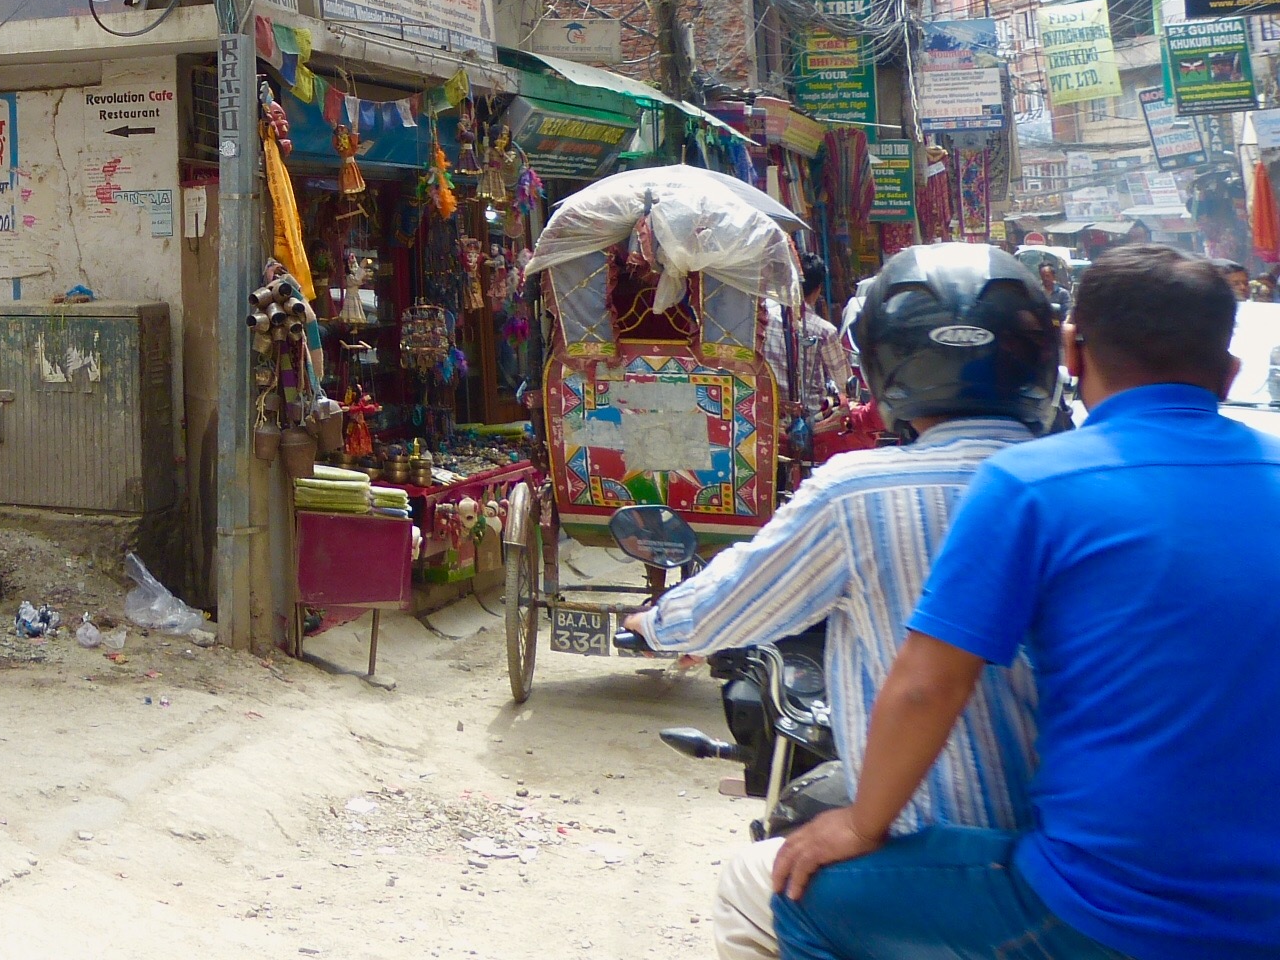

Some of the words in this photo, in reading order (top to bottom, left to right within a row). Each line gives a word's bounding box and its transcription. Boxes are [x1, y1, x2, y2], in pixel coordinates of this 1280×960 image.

[1188, 21, 1242, 35] GURKHA
[1170, 38, 1211, 50] KHUKURI
[1213, 34, 1246, 46] HOUSE
[1048, 47, 1099, 69] TREKKING
[820, 71, 848, 80] TOUR
[1050, 73, 1074, 92] PVT.
[1075, 69, 1102, 88] LTD.
[86, 91, 145, 105] Revolution
[148, 90, 173, 101] Cafe
[99, 108, 160, 120] Restaurant
[555, 630, 607, 655] 334
